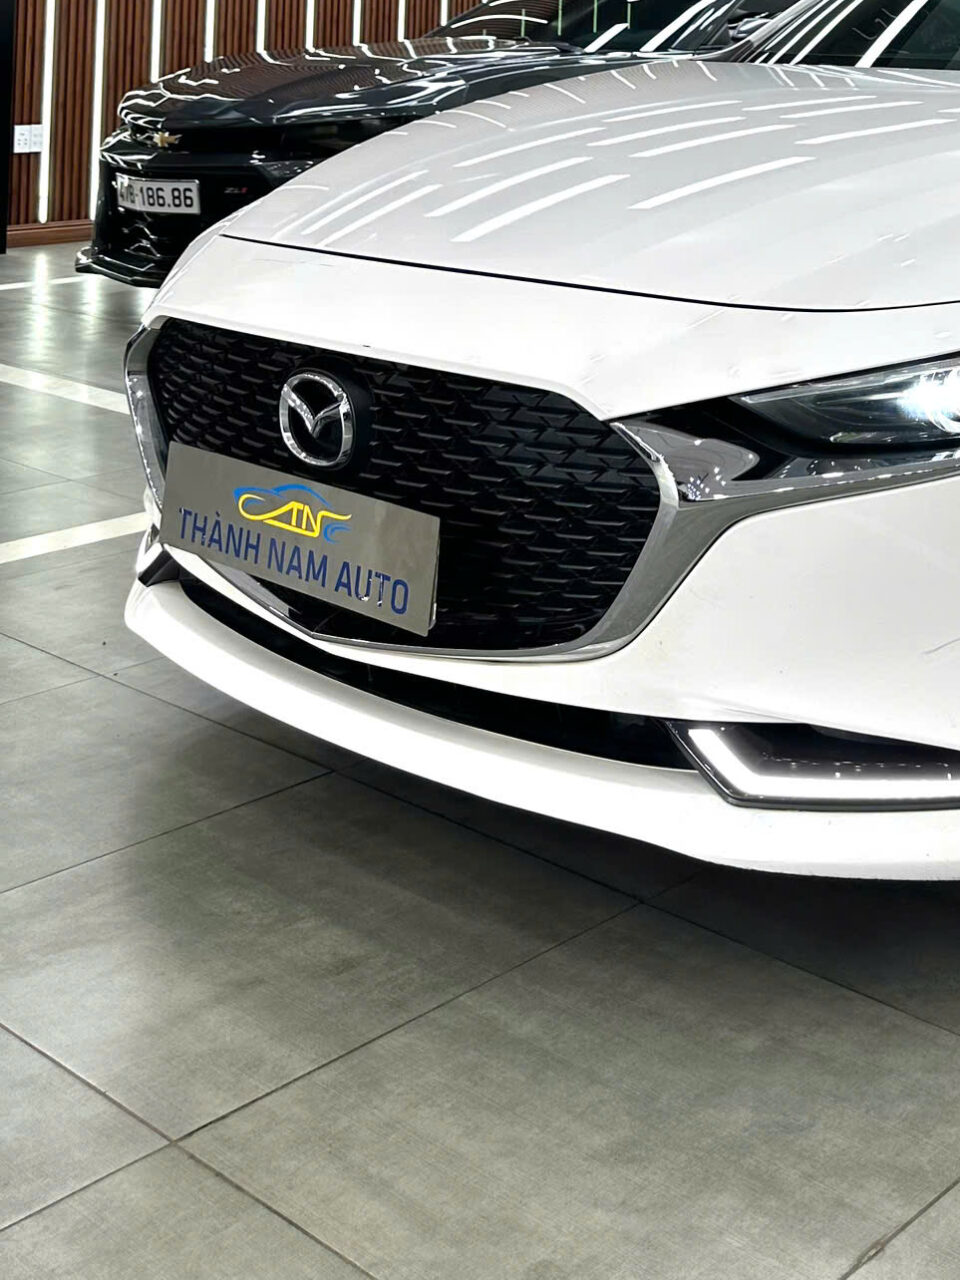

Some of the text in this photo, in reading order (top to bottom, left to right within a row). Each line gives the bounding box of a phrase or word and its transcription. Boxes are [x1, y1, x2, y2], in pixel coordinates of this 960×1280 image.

[178, 507, 410, 615] THÀNH NAM AUTO
